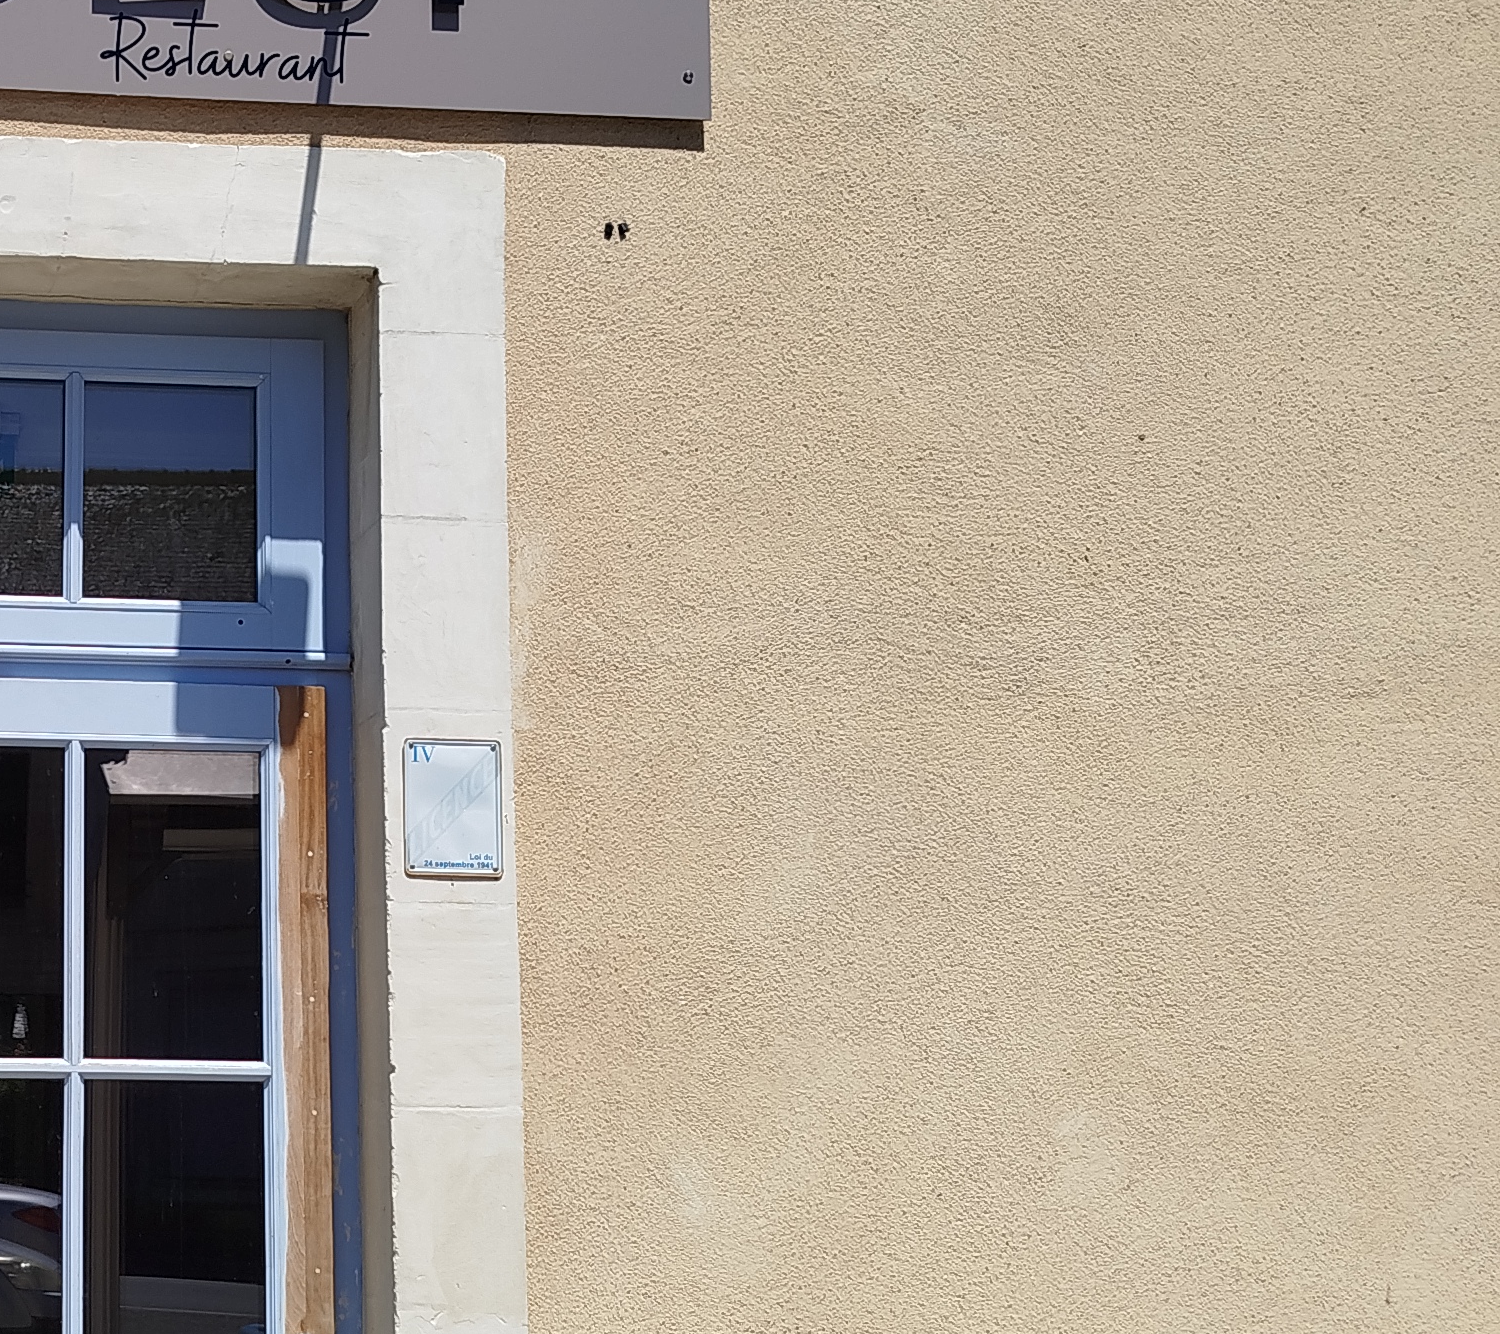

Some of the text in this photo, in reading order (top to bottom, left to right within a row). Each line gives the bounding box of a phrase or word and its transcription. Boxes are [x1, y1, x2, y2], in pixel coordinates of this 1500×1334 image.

[100, 9, 369, 82] Restaurant
[410, 745, 436, 763] IV
[469, 853, 493, 861] Loi du
[434, 861, 475, 870] septembre
[476, 861, 494, 869] 1941
